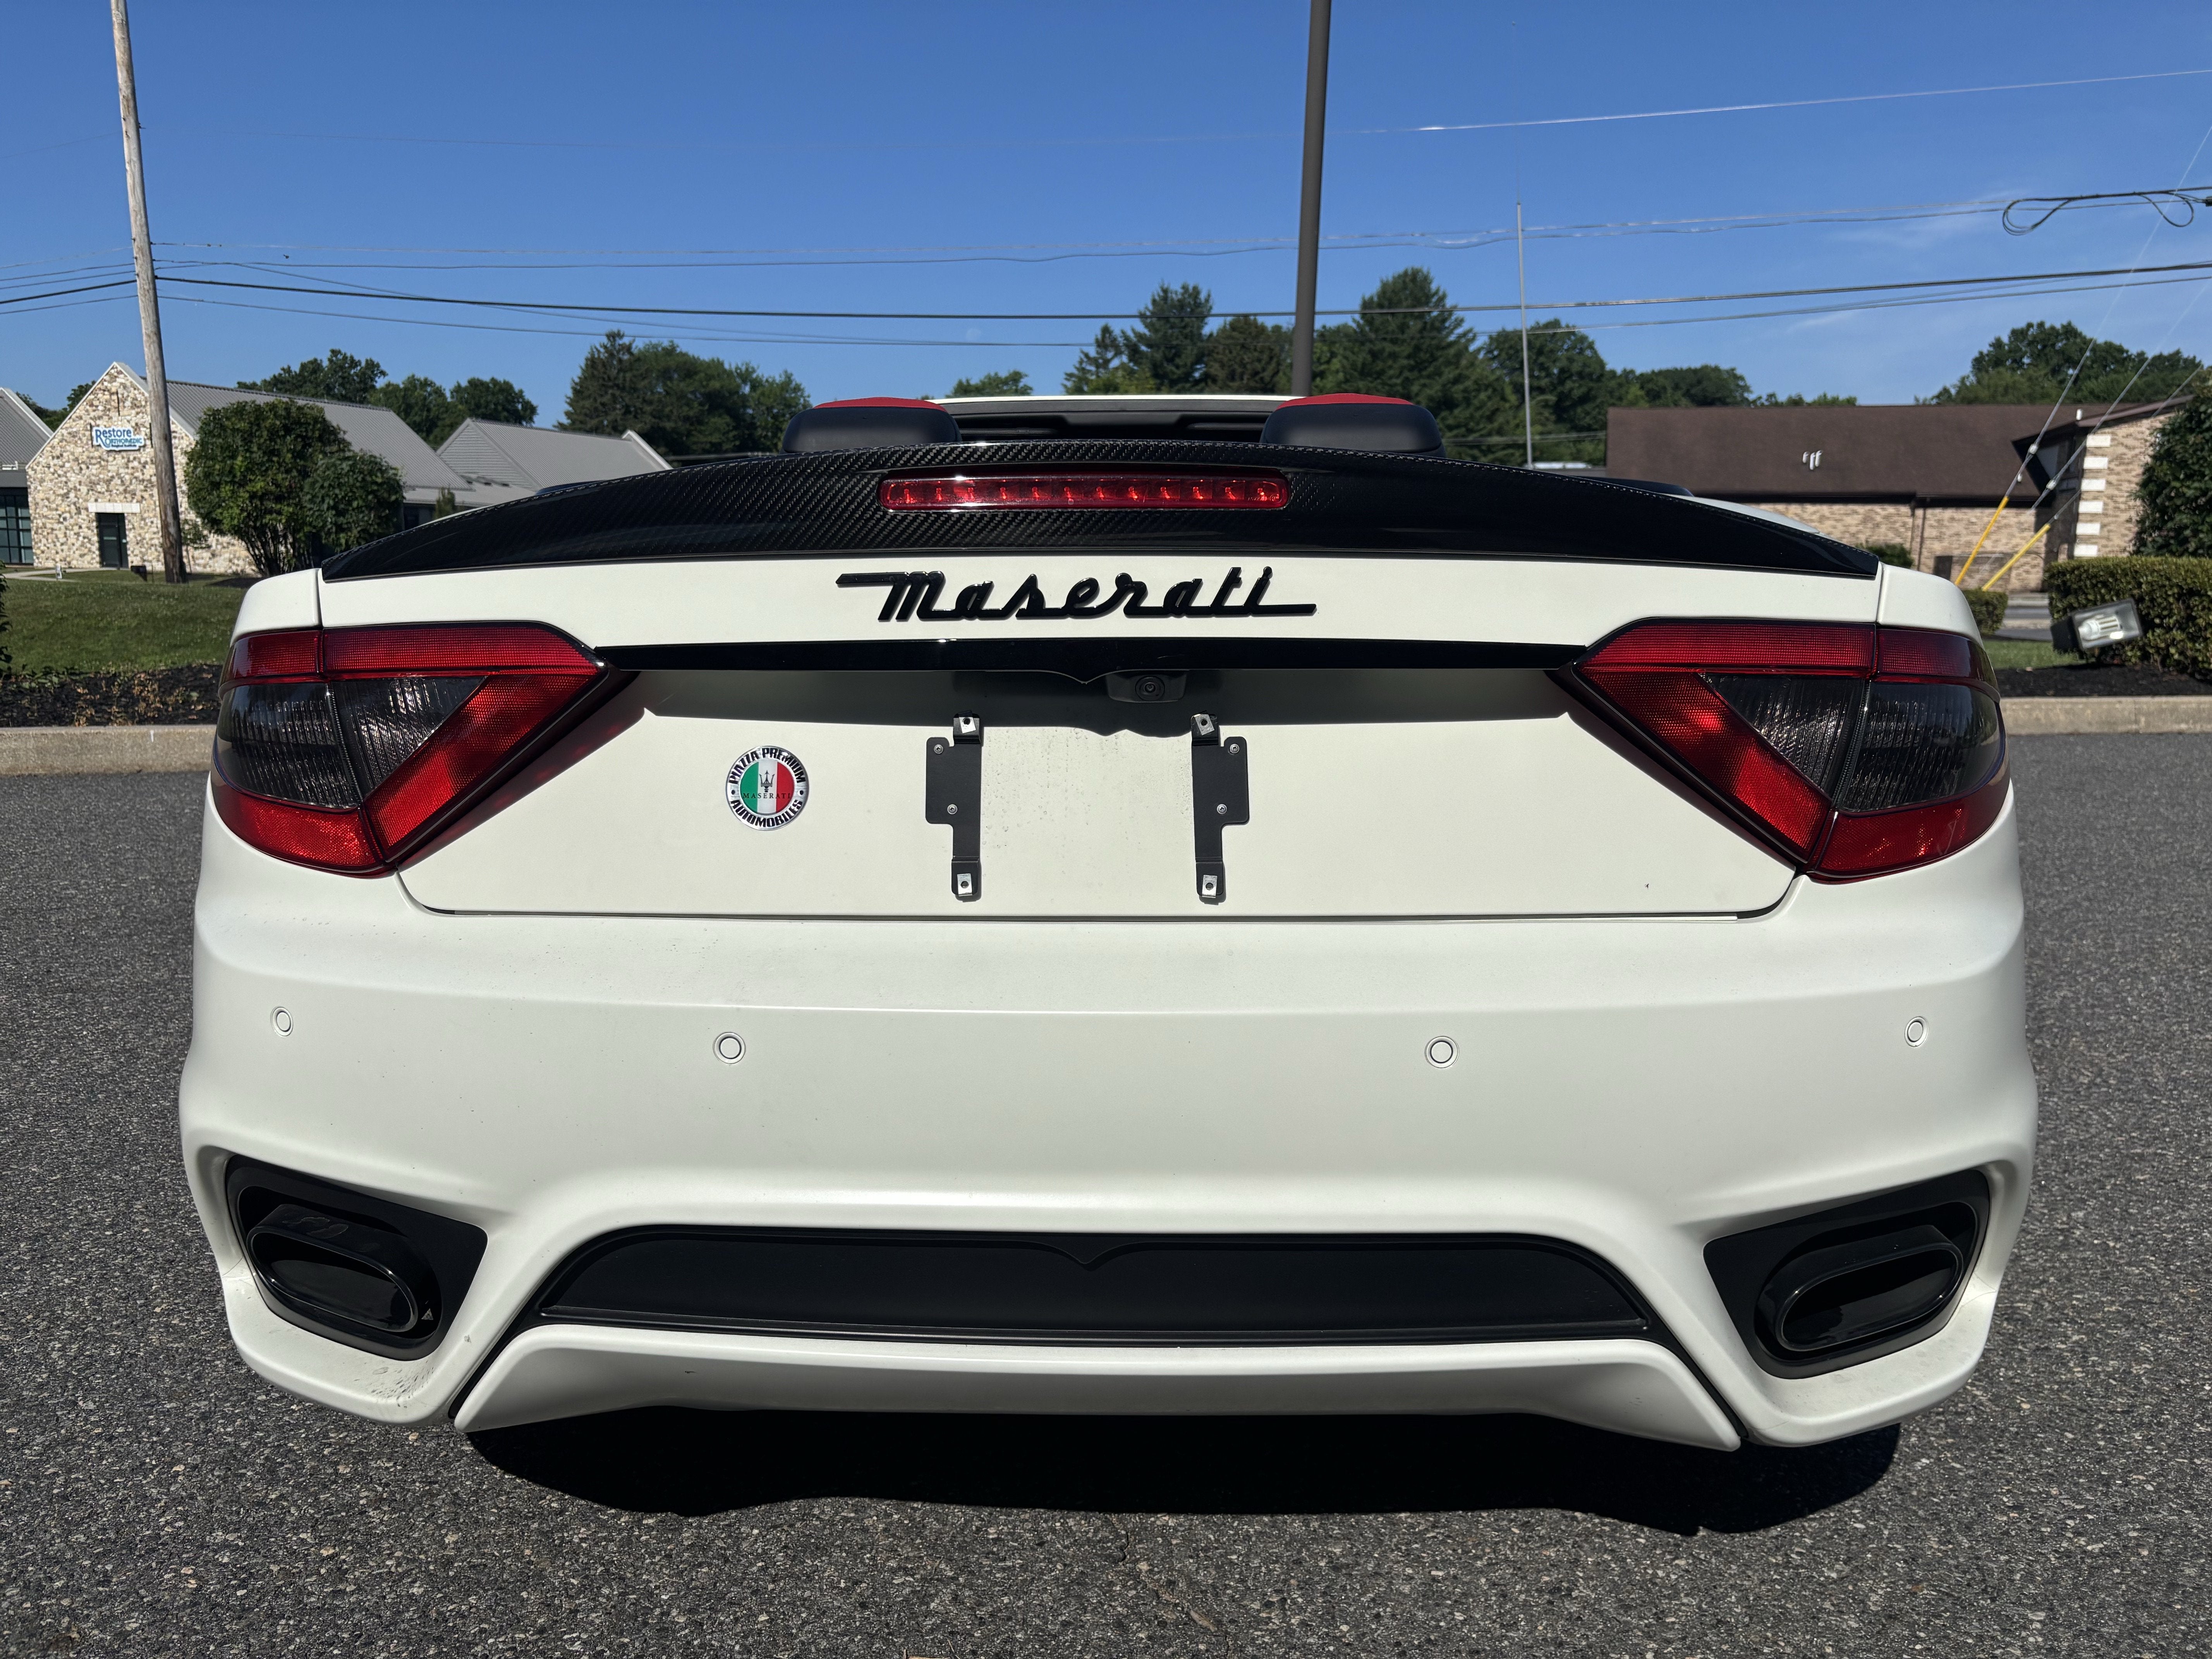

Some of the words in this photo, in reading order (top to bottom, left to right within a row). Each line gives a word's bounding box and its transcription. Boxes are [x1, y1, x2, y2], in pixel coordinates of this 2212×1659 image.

[95, 428, 132, 447] Restore
[835, 566, 1316, 621] Maserati
[729, 750, 759, 784] PIAZZA
[762, 748, 806, 783] PREMIUM
[730, 799, 803, 828] AUTOMOBILES
